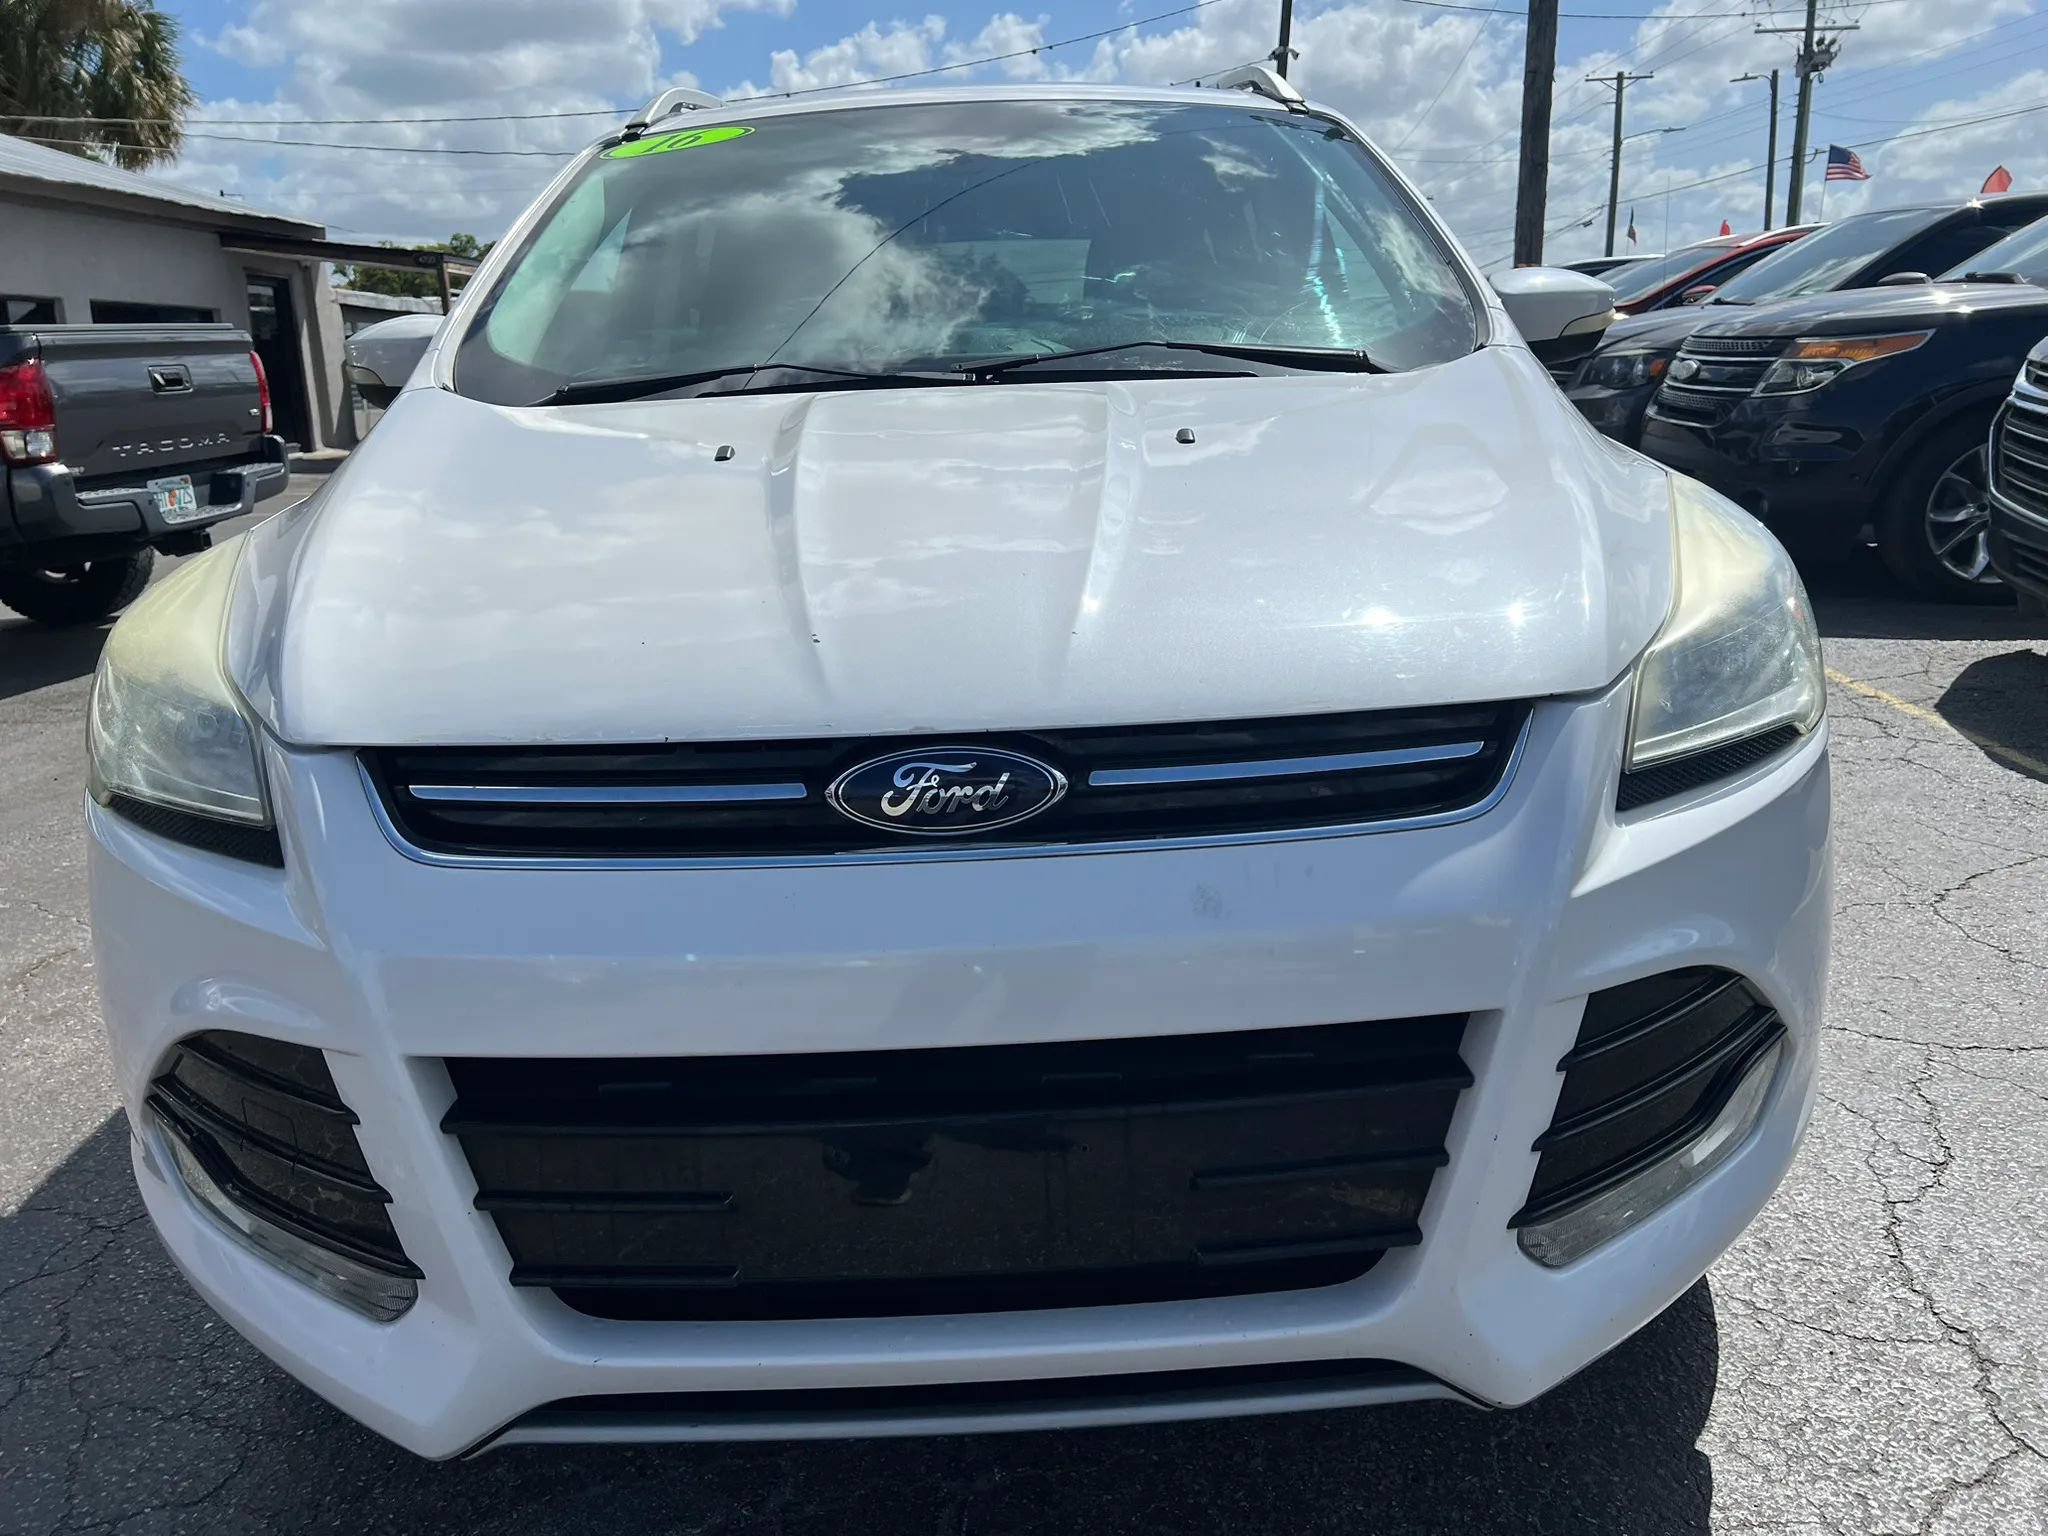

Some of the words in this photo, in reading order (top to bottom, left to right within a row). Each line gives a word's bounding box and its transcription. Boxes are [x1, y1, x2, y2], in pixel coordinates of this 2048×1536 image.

[640, 129, 713, 154] 16
[111, 432, 231, 458] TACOMA
[880, 761, 1011, 817] Ford
